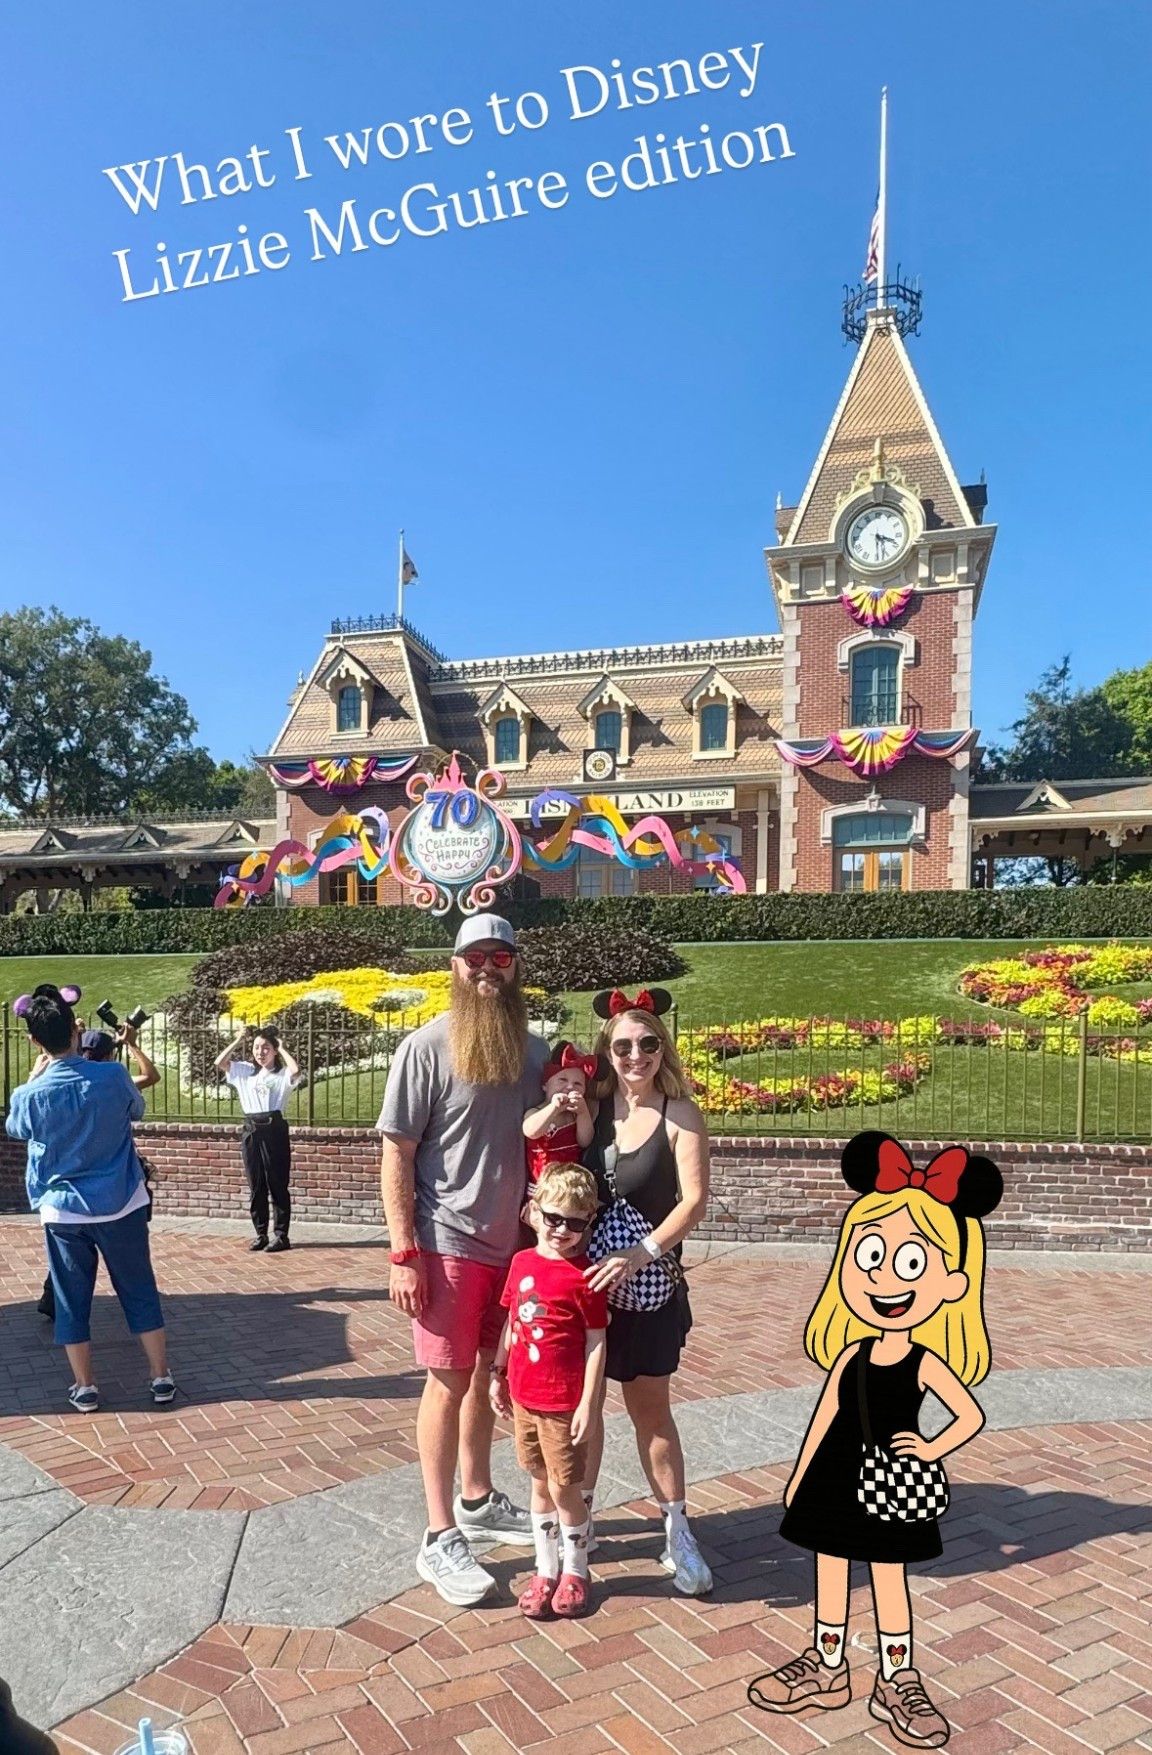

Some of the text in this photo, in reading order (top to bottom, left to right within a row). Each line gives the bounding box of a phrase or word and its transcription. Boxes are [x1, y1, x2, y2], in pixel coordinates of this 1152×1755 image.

[689, 789, 729, 799] ELEVATION
[706, 798, 726, 806] FEET
[425, 789, 478, 830] 70
